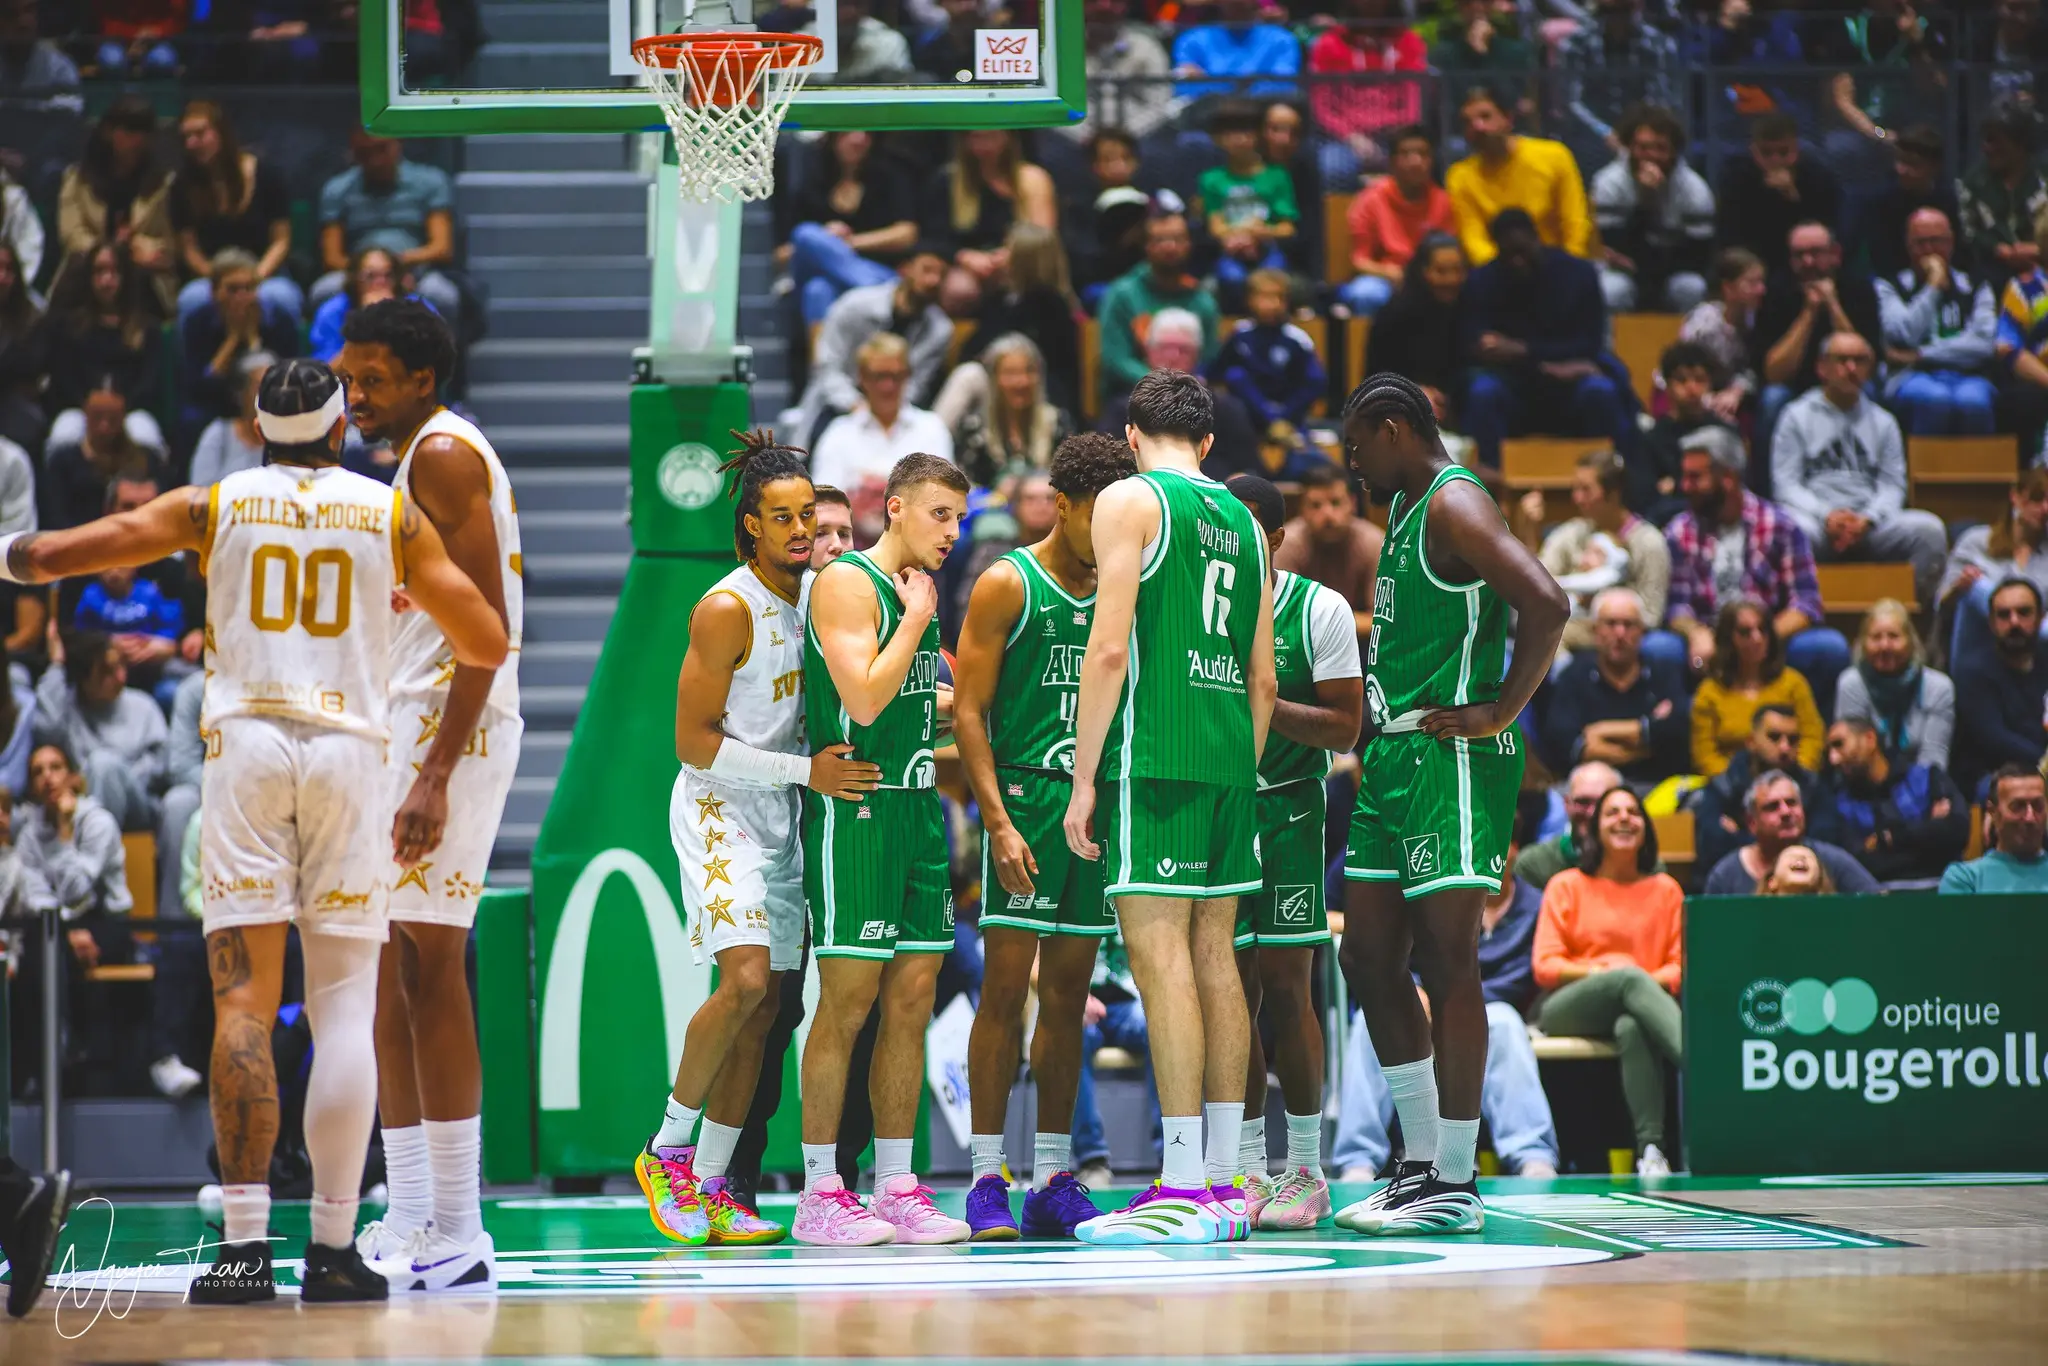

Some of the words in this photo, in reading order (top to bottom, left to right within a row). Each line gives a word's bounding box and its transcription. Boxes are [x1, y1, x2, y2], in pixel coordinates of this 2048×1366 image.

[250, 543, 353, 637] 00
[922, 700, 933, 742] 3
[1495, 731, 1516, 755] 19
[862, 921, 884, 938] isf
[1883, 996, 2000, 1034] optique
[1742, 1031, 2048, 1104] Bougeroll
